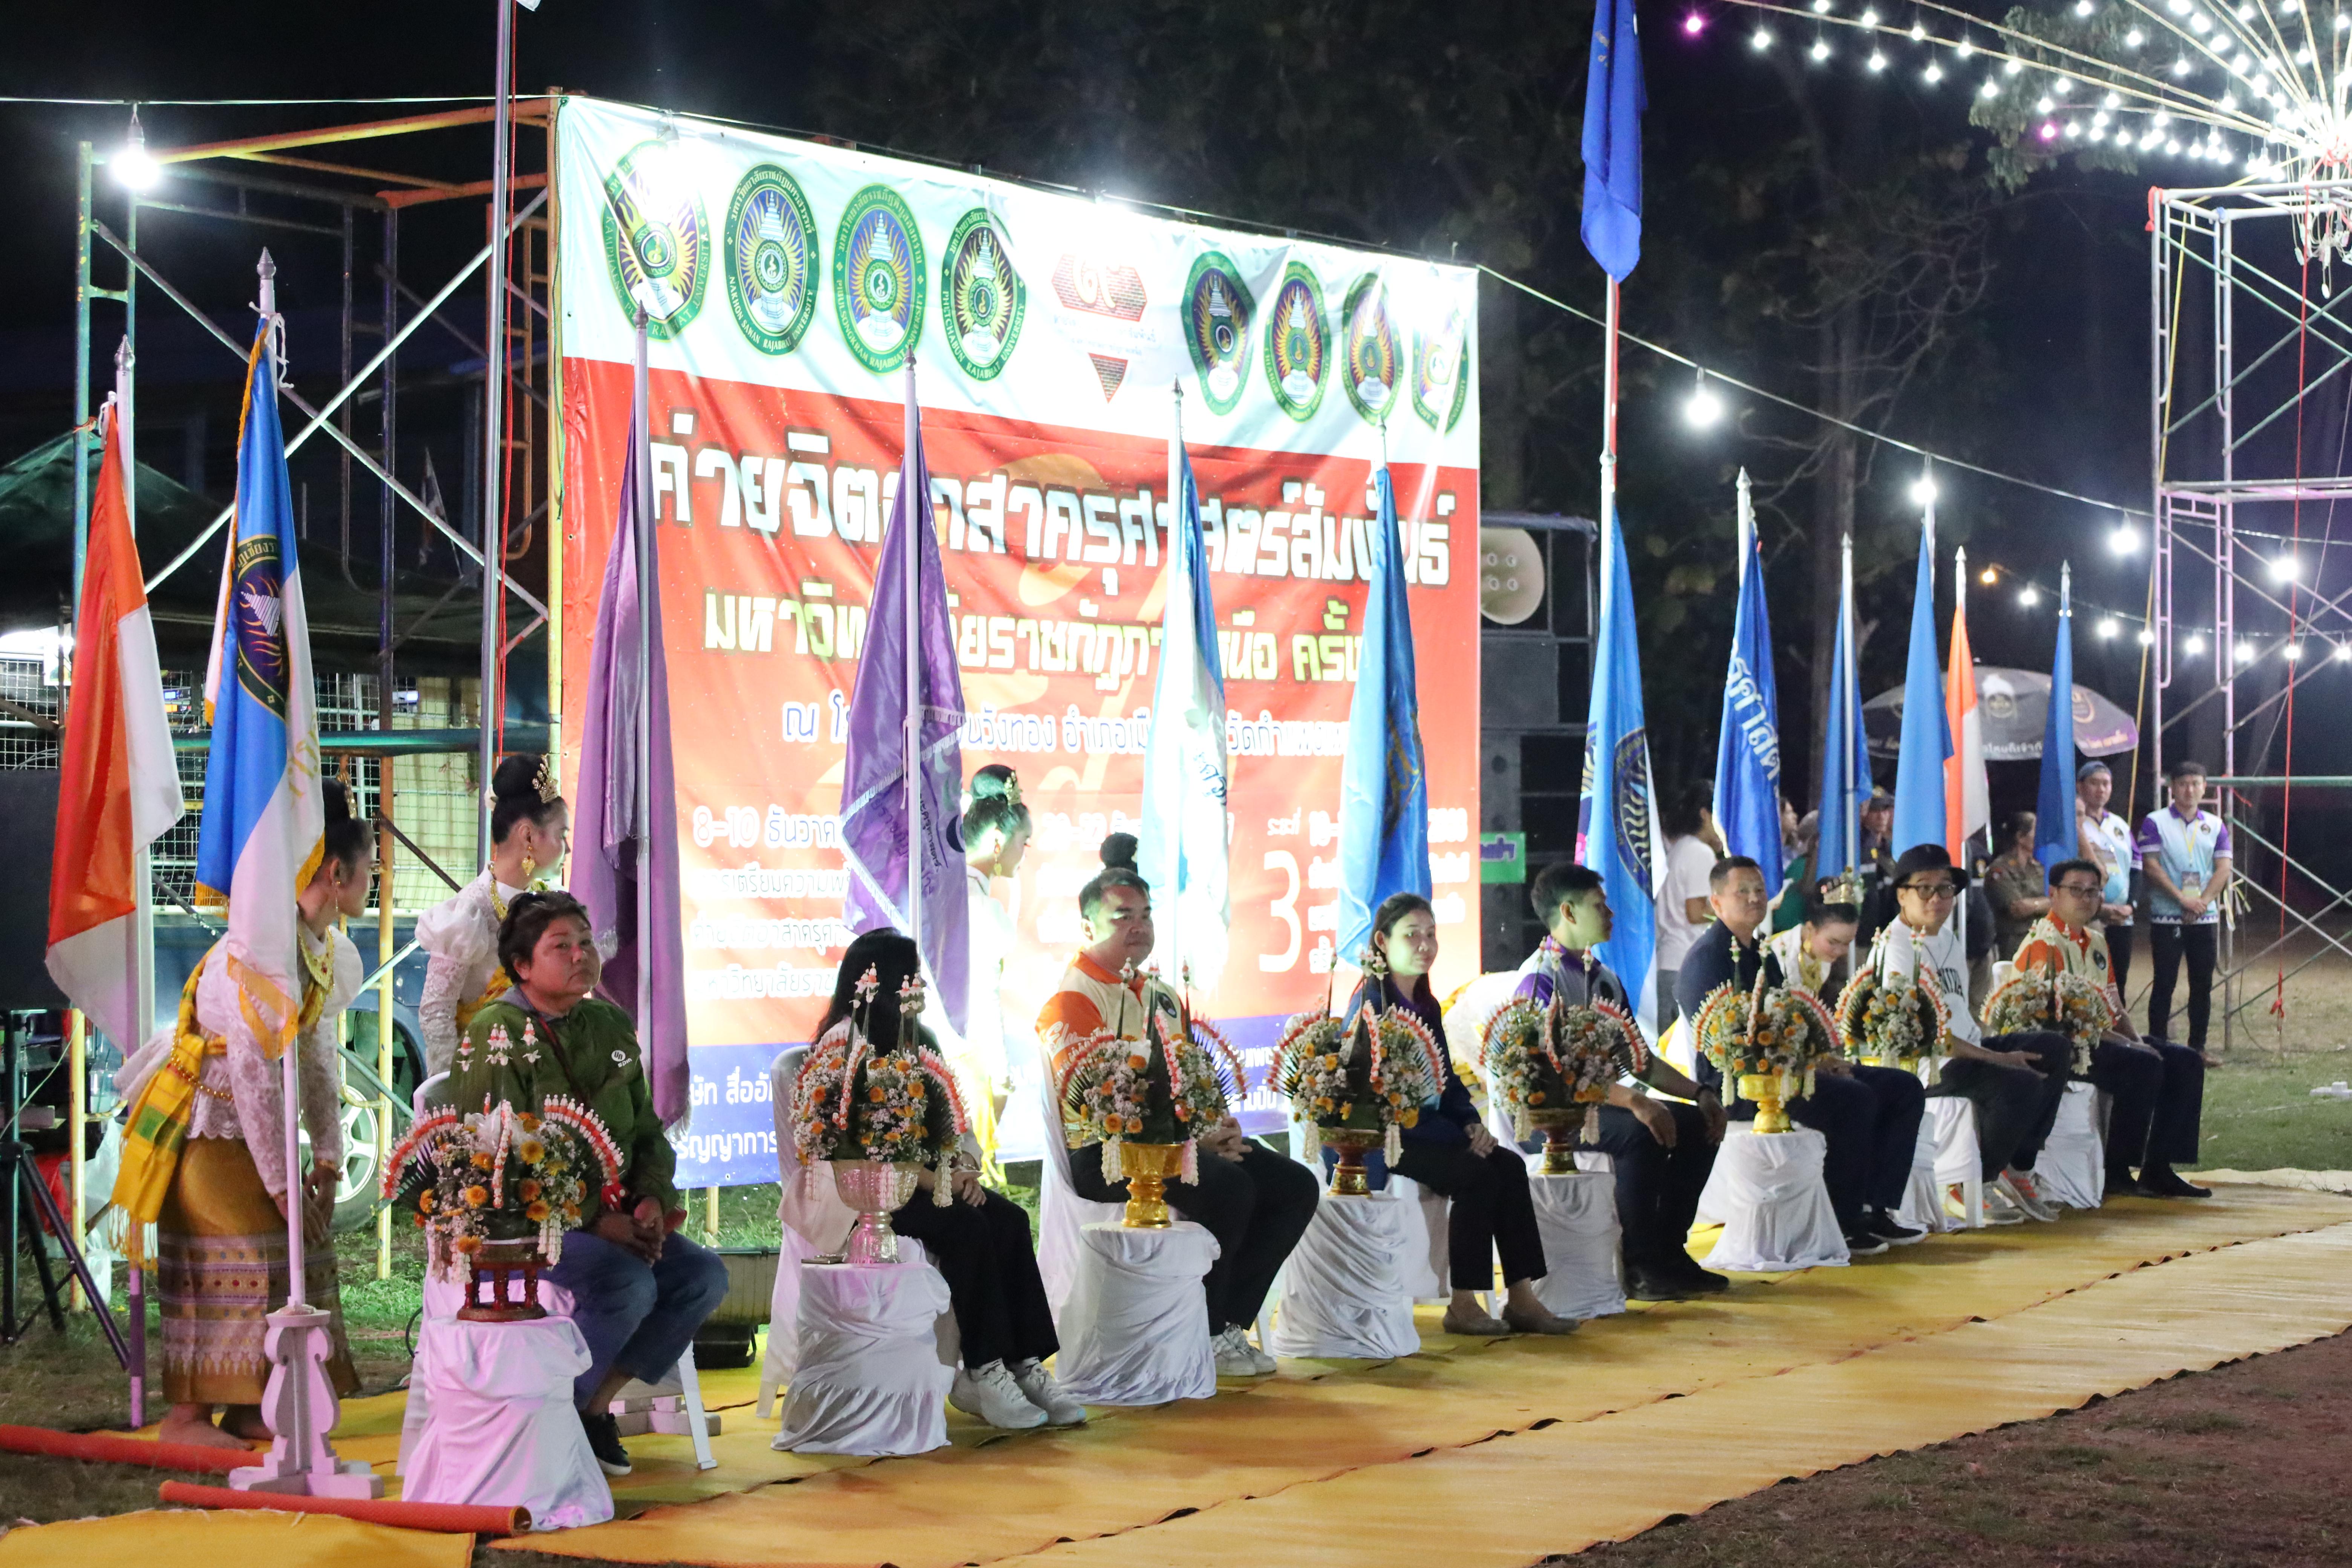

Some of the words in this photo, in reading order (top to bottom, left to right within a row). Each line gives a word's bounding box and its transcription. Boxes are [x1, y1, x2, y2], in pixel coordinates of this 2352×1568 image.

[729, 276, 744, 320] NAKHON
[741, 319, 761, 344] SAWAN
[763, 336, 792, 352] RAJABHAT
[869, 348, 905, 371] RAJABHAT
[767, 807, 839, 845] ธันวาค
[1259, 850, 1302, 973] 3
[617, 1058, 633, 1068] spin
